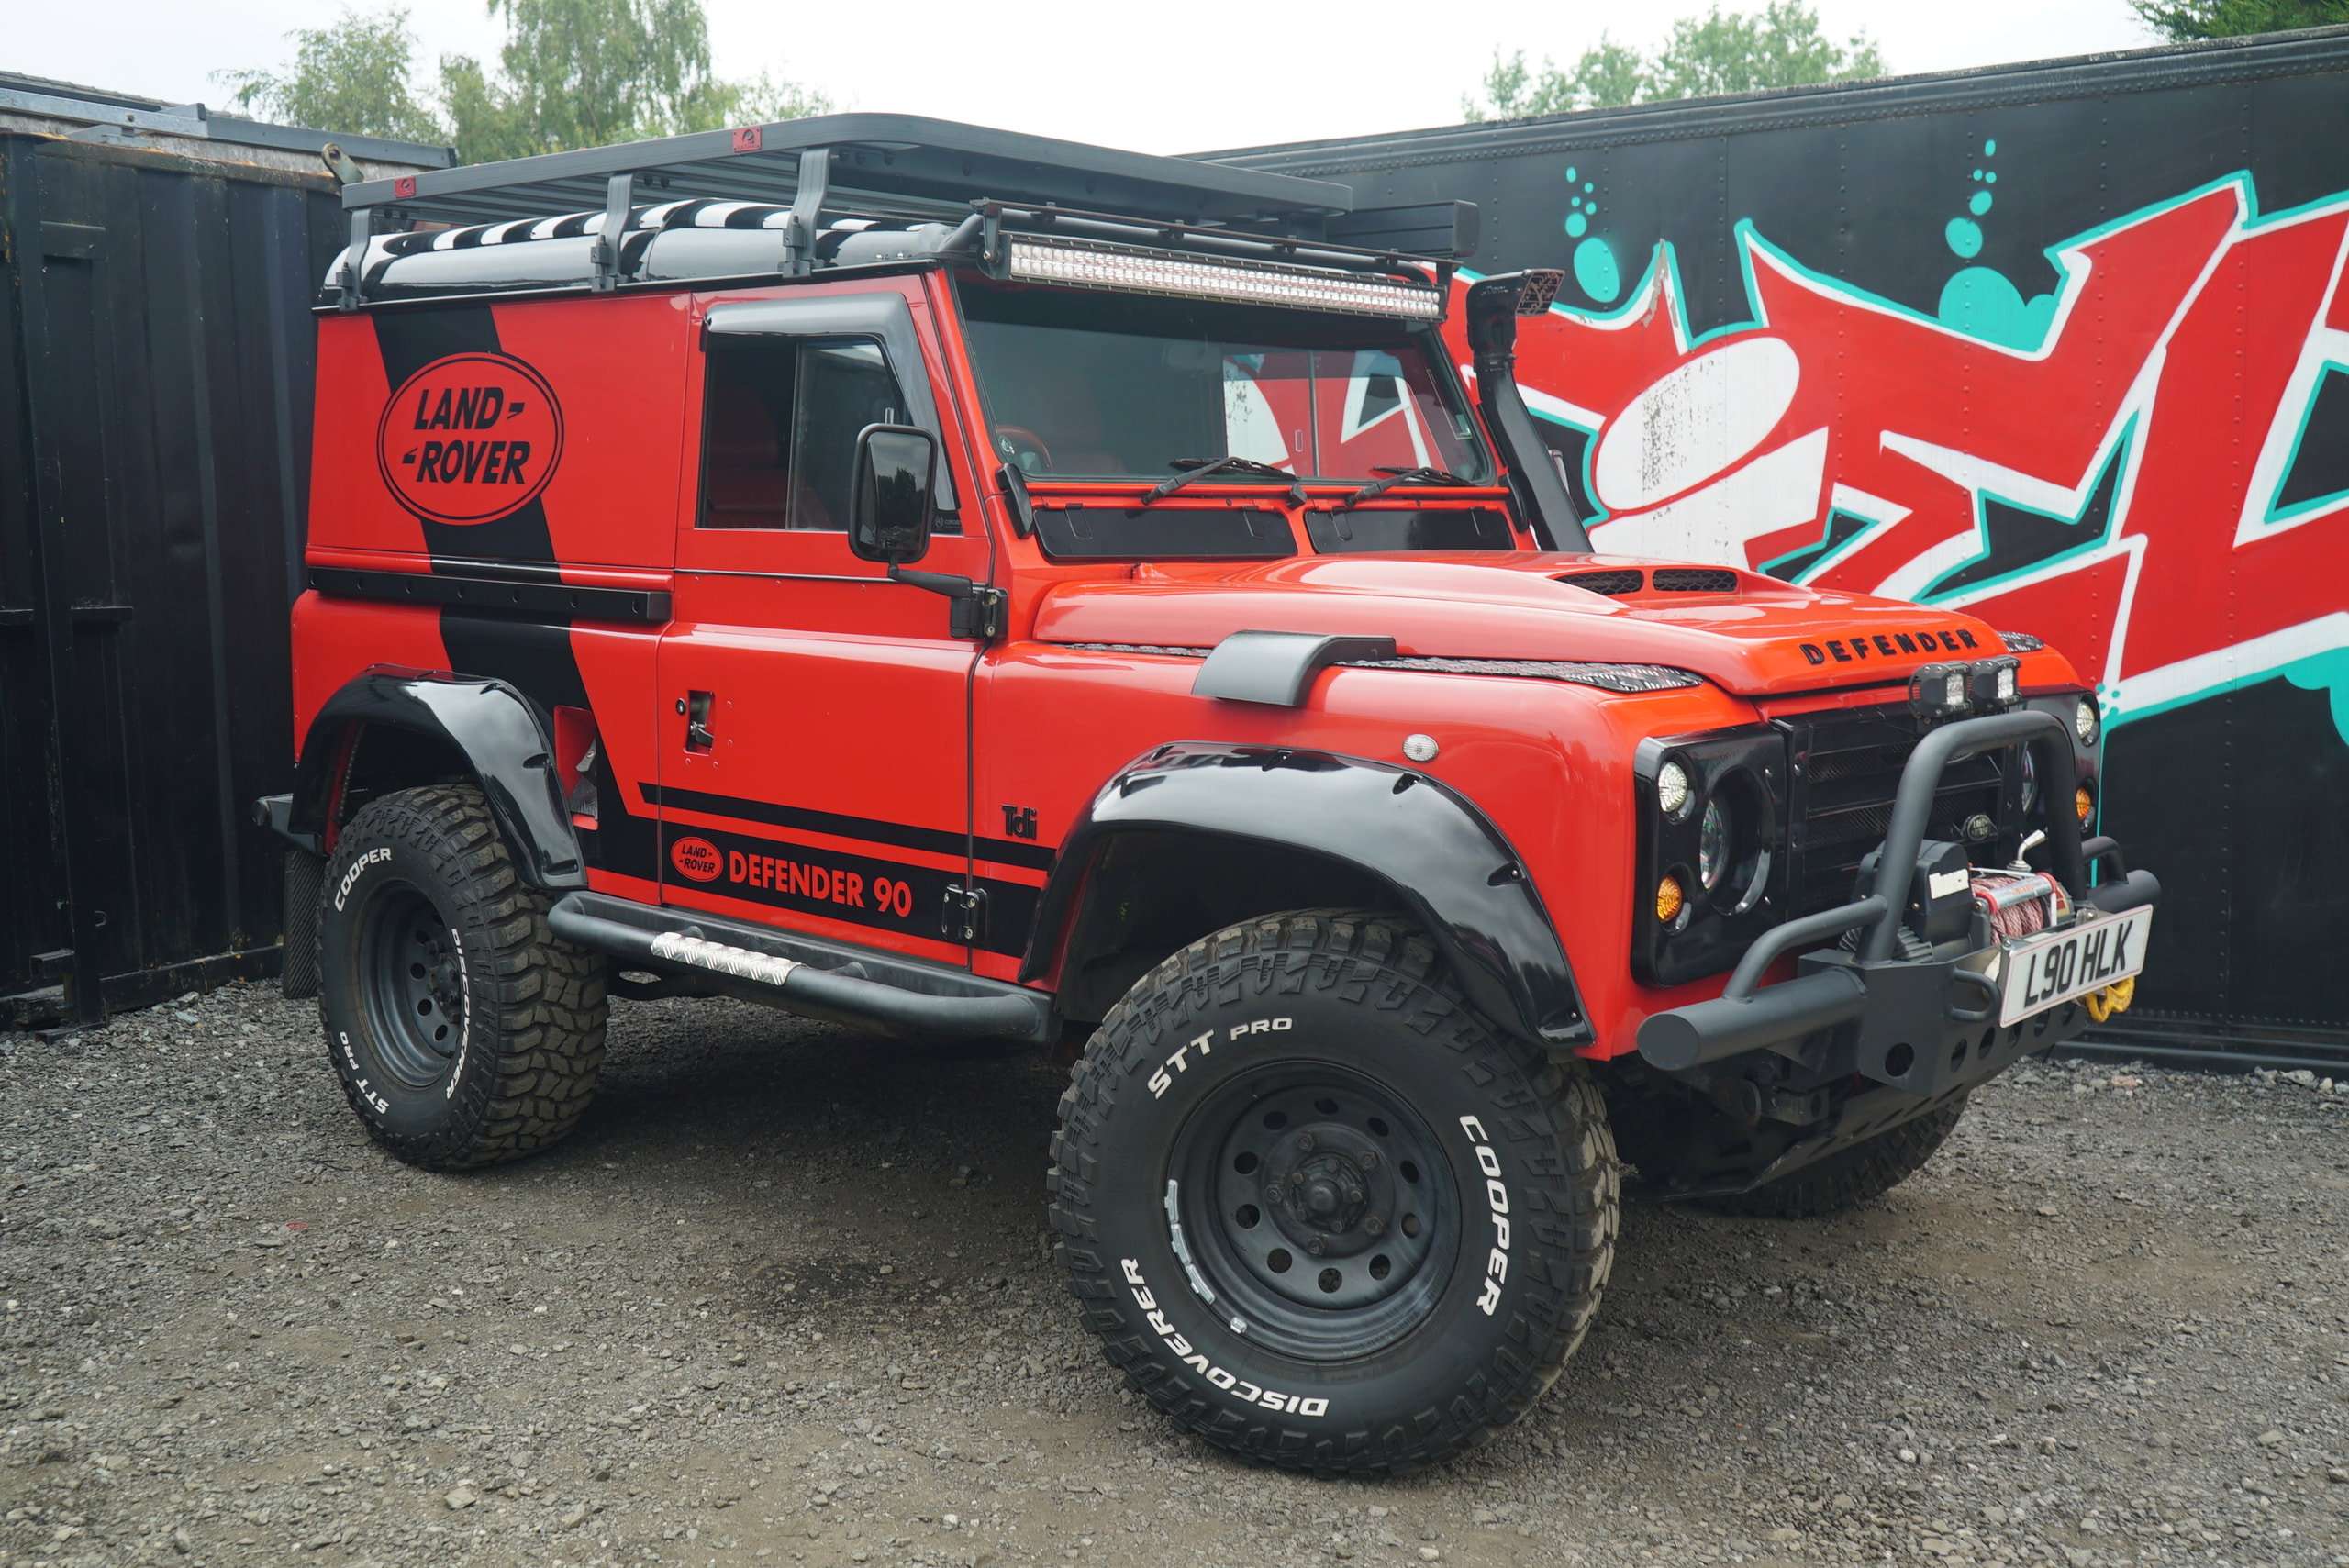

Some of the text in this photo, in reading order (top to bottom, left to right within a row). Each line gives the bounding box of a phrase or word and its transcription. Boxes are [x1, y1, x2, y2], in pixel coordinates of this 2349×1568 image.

[414, 386, 505, 430] LAND
[416, 439, 531, 485] ROVER
[1799, 629, 1979, 665] DEFENDER
[1001, 804, 1037, 840] Tdi
[334, 847, 393, 913] COOPER
[729, 850, 913, 918] DEFENDER 90
[2023, 919, 2134, 1008] L90 HLK
[446, 927, 472, 1101] DISCOVERER
[339, 1030, 390, 1115] STT PRO
[1147, 1017, 1293, 1101] STT PRO
[1459, 1115, 1511, 1317] COOPER
[1120, 1257, 1330, 1418] DISCOVERER
